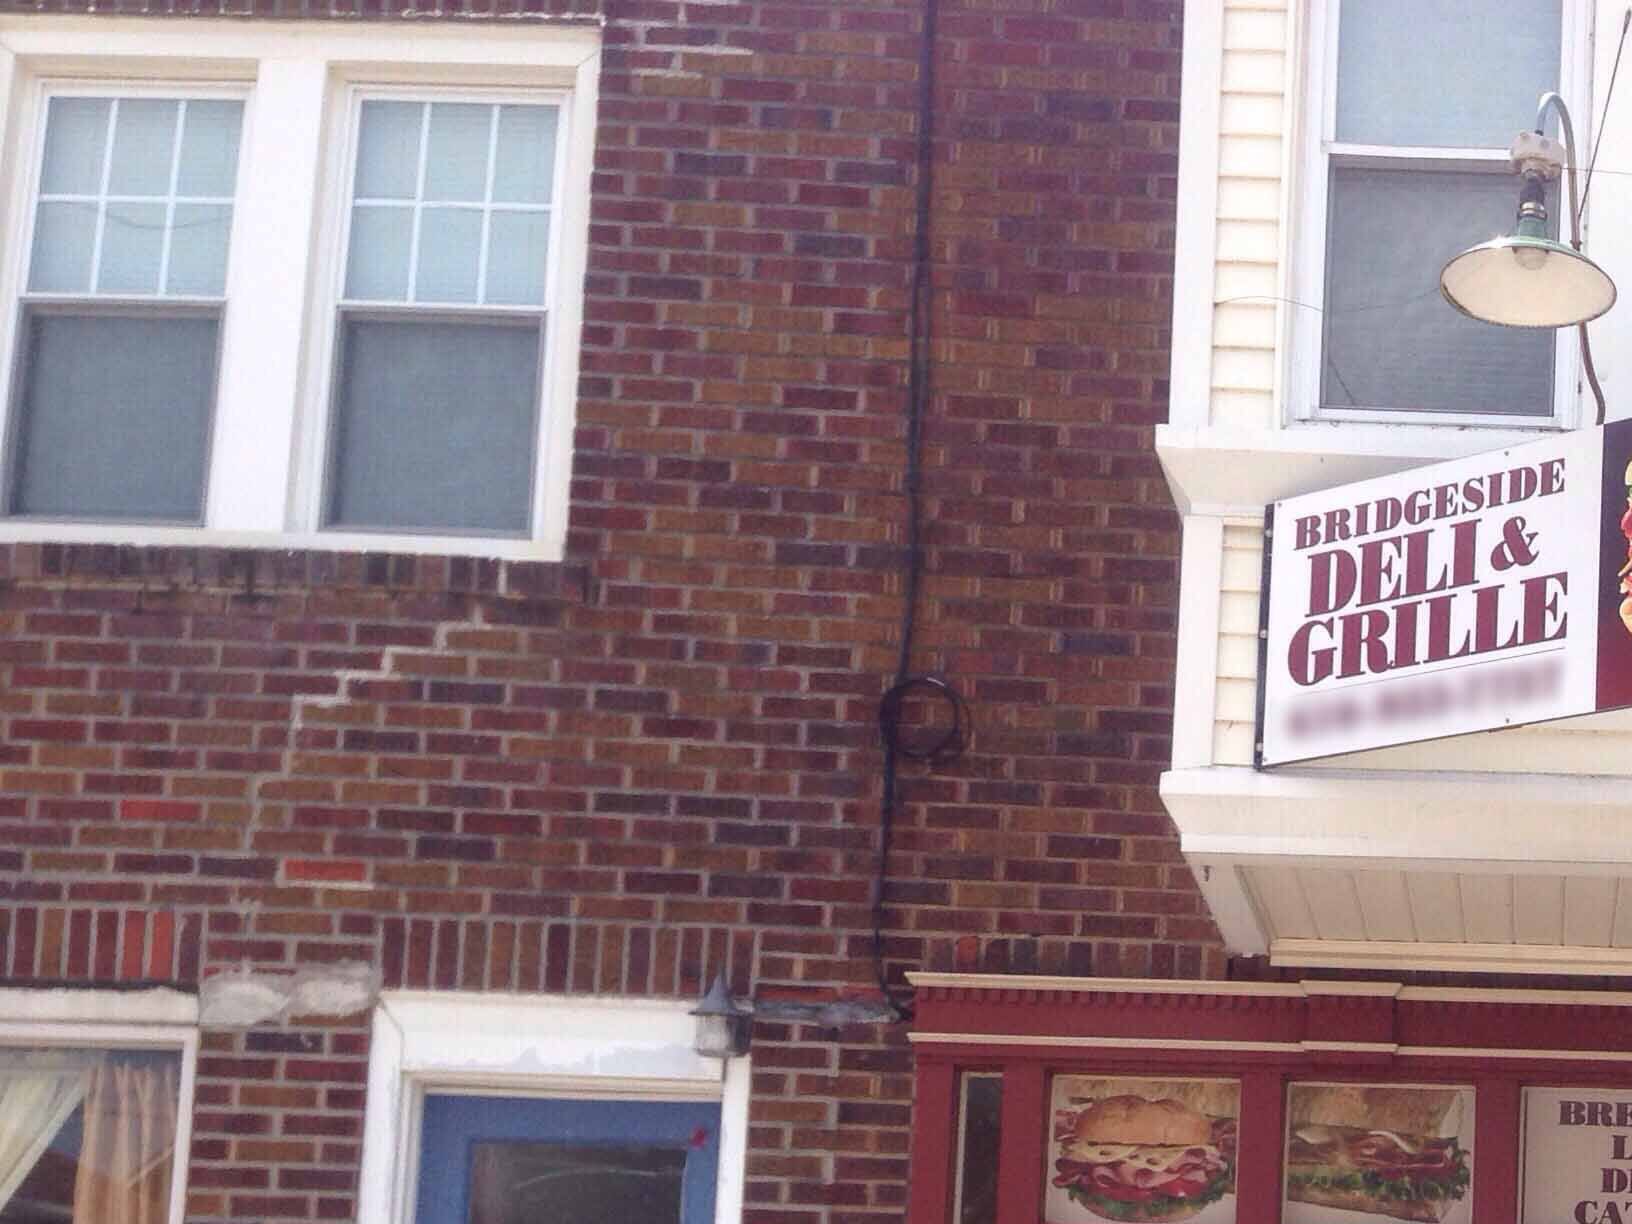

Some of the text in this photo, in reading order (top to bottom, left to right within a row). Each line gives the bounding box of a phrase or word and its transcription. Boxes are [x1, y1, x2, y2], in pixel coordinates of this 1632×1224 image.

[1294, 458, 1566, 550] BRIDGESIDE
[1305, 516, 1539, 617] DELI &
[1288, 572, 1568, 686] GRILLE
